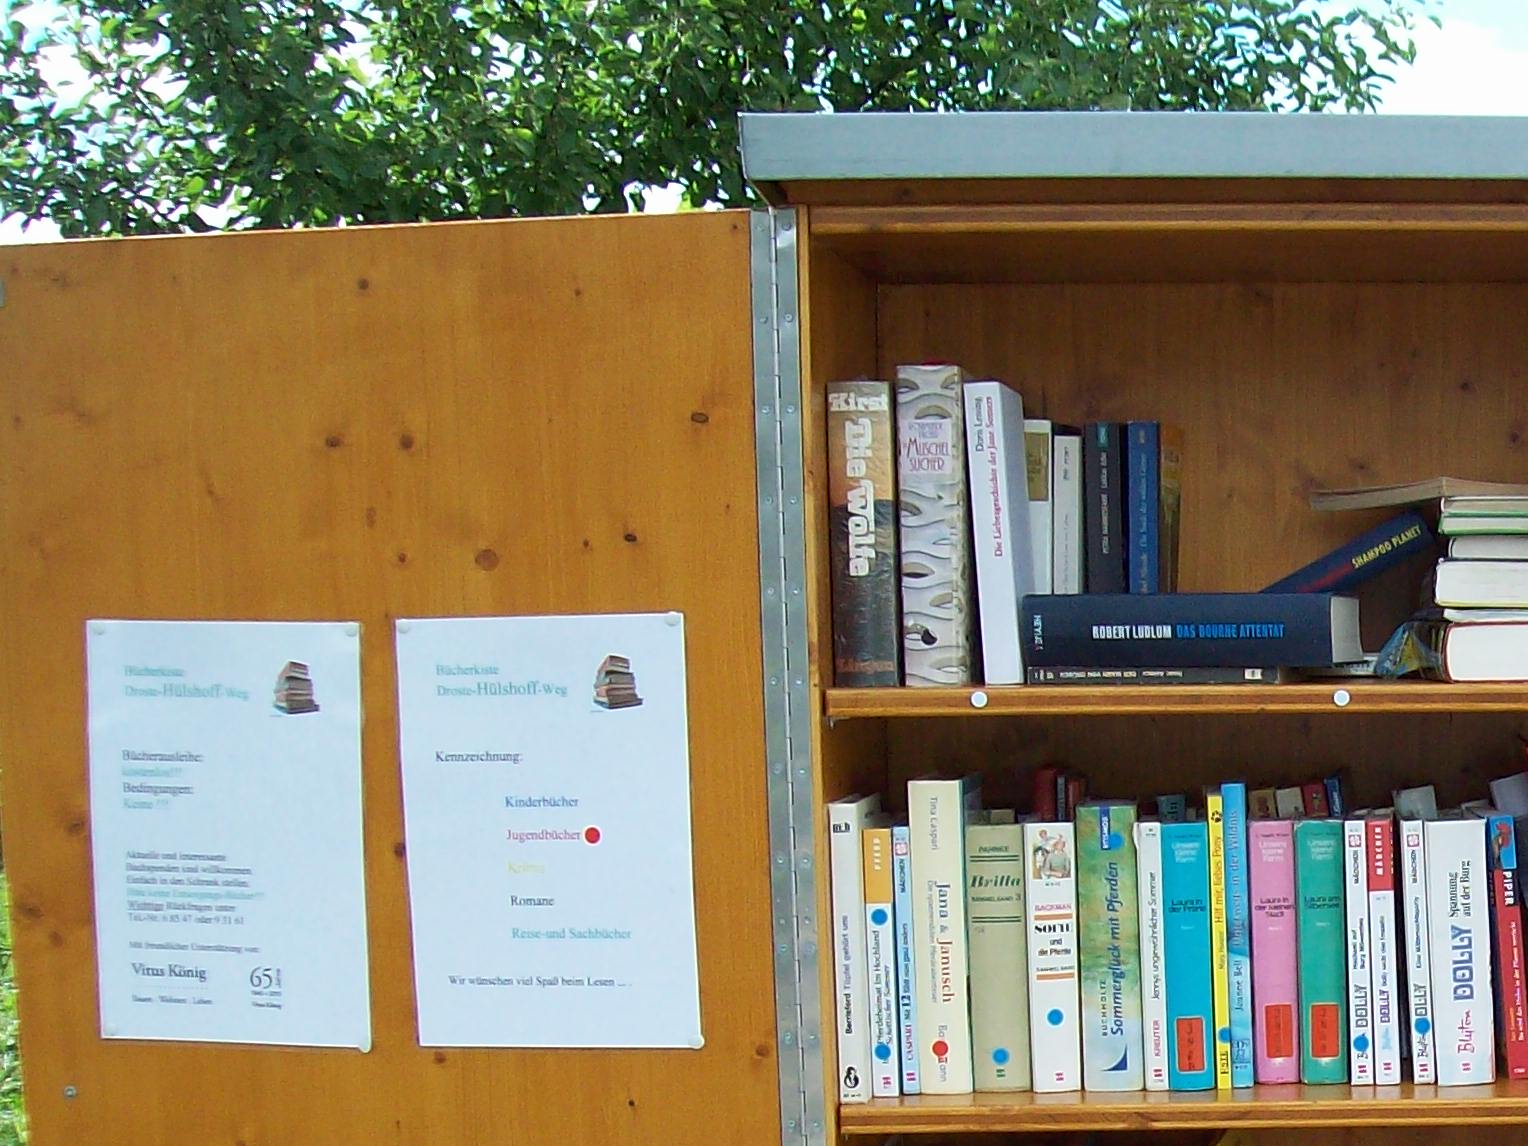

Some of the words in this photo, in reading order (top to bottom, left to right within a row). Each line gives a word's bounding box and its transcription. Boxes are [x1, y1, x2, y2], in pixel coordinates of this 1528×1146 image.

[1351, 539, 1393, 569] SHAMPOO
[1092, 625, 1130, 639] ROBERT
[1133, 625, 1172, 639] LUDLUM
[505, 795, 579, 809] Kinderbücher
[929, 796, 939, 815] Tina
[506, 829, 581, 843] Jugendbücher
[928, 817, 939, 851] Caspari
[1107, 862, 1124, 913] Pferden
[1459, 860, 1471, 883] Burg
[1503, 870, 1515, 906] PIPER
[510, 895, 555, 907] Romane
[934, 881, 952, 920] Jana
[1147, 871, 1157, 906] Sommer
[1448, 871, 1461, 918] Spannung
[1460, 885, 1470, 901] der
[1461, 902, 1471, 917] auf
[569, 928, 631, 940] Sachbücher
[1107, 917, 1120, 941] mit
[872, 930, 881, 972] Hochland
[1450, 924, 1474, 1001] DOLLY
[936, 937, 955, 1003] Janusch
[901, 994, 911, 1007] 12
[1109, 944, 1125, 1037] Sommerglück
[1234, 979, 1245, 1012] Joanne
[1354, 984, 1368, 1028] DOLLY
[1379, 989, 1391, 1024] DOLLY
[1414, 984, 1427, 1017] OLLY
